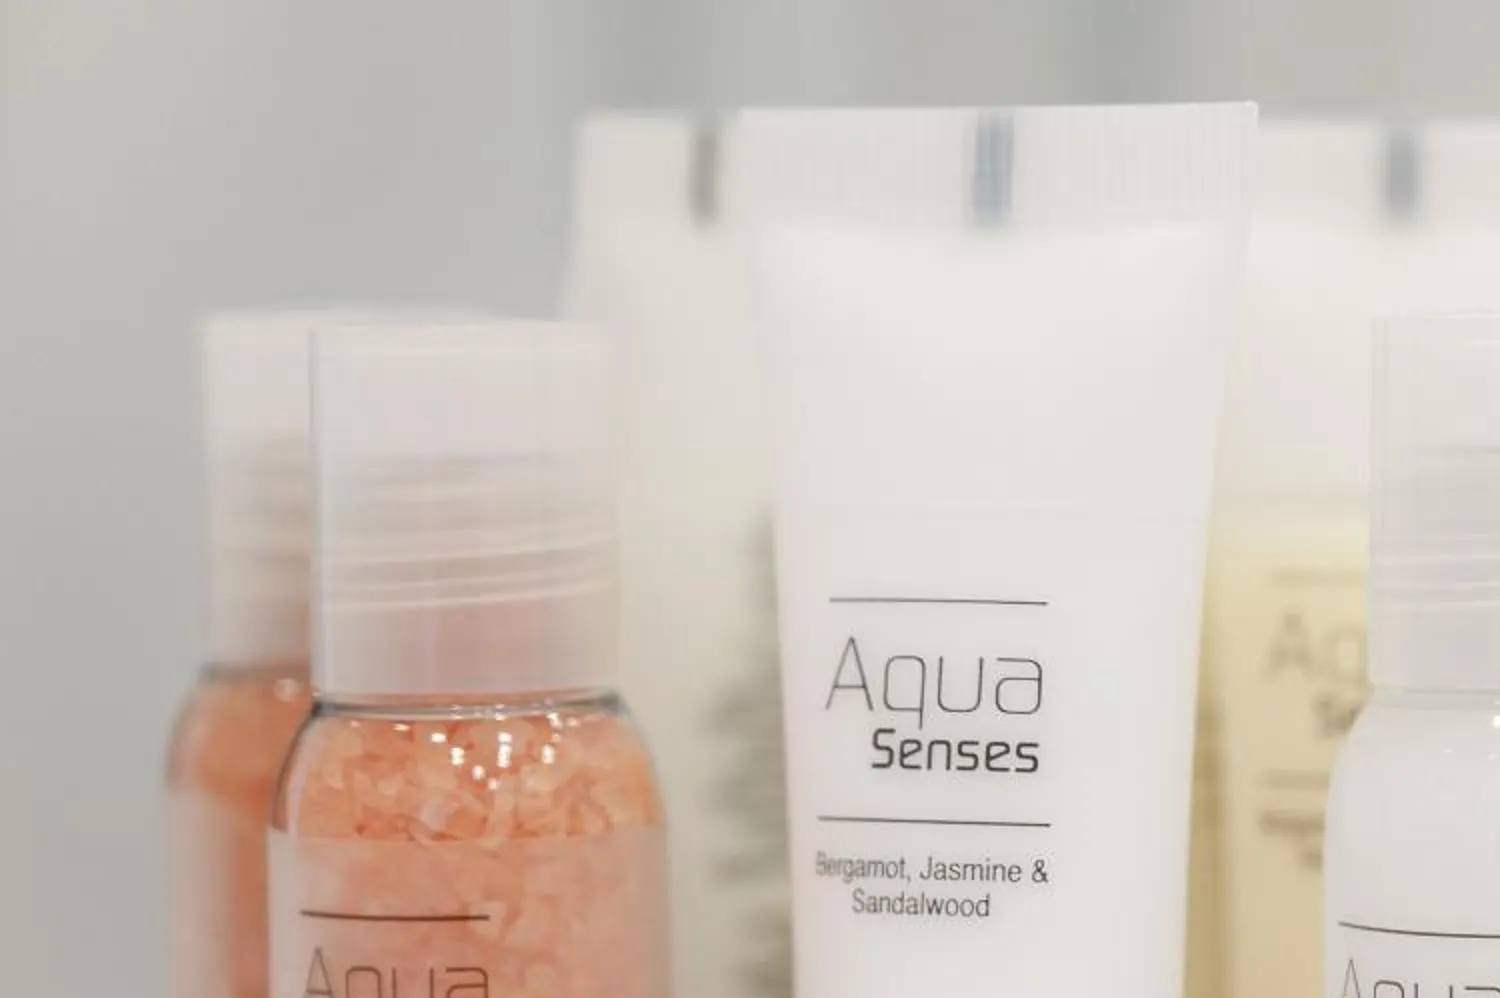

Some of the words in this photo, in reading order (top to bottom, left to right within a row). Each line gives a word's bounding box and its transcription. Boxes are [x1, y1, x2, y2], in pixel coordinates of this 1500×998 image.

[825, 636, 1043, 729] Aqua
[871, 728, 1039, 773] Senses
[815, 850, 911, 884] Bergamot,
[919, 856, 1022, 884] Jasmine
[1031, 858, 1049, 883] &
[851, 887, 991, 917] Sandalwood
